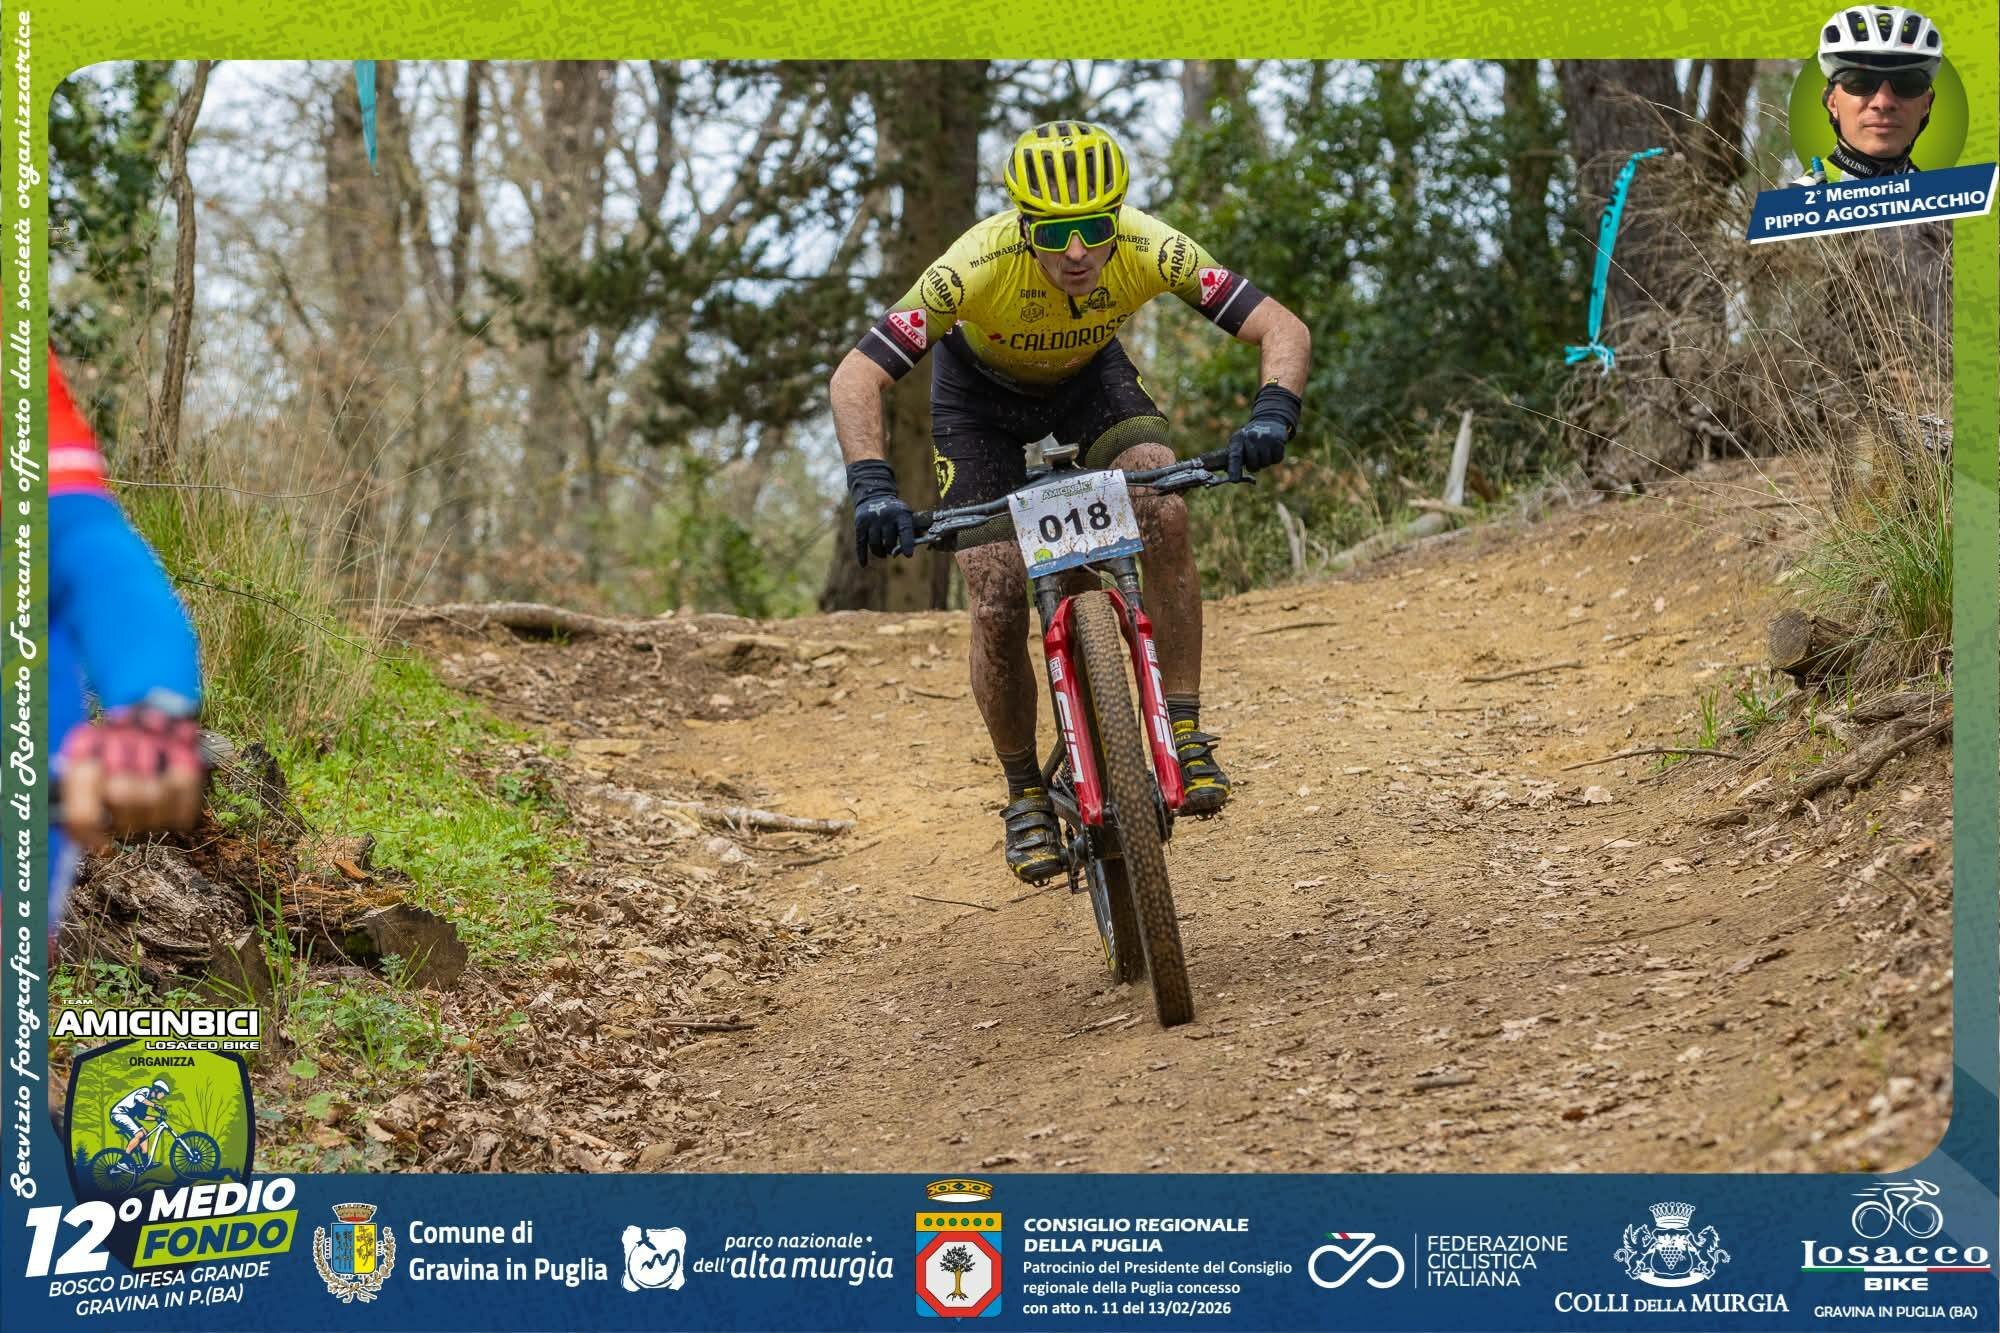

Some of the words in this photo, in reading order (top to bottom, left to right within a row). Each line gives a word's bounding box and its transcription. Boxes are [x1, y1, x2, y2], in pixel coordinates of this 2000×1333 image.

[1020, 288, 1047, 299] GOBIK
[1009, 311, 1133, 352] CALDOROSS
[1038, 500, 1112, 543] 018
